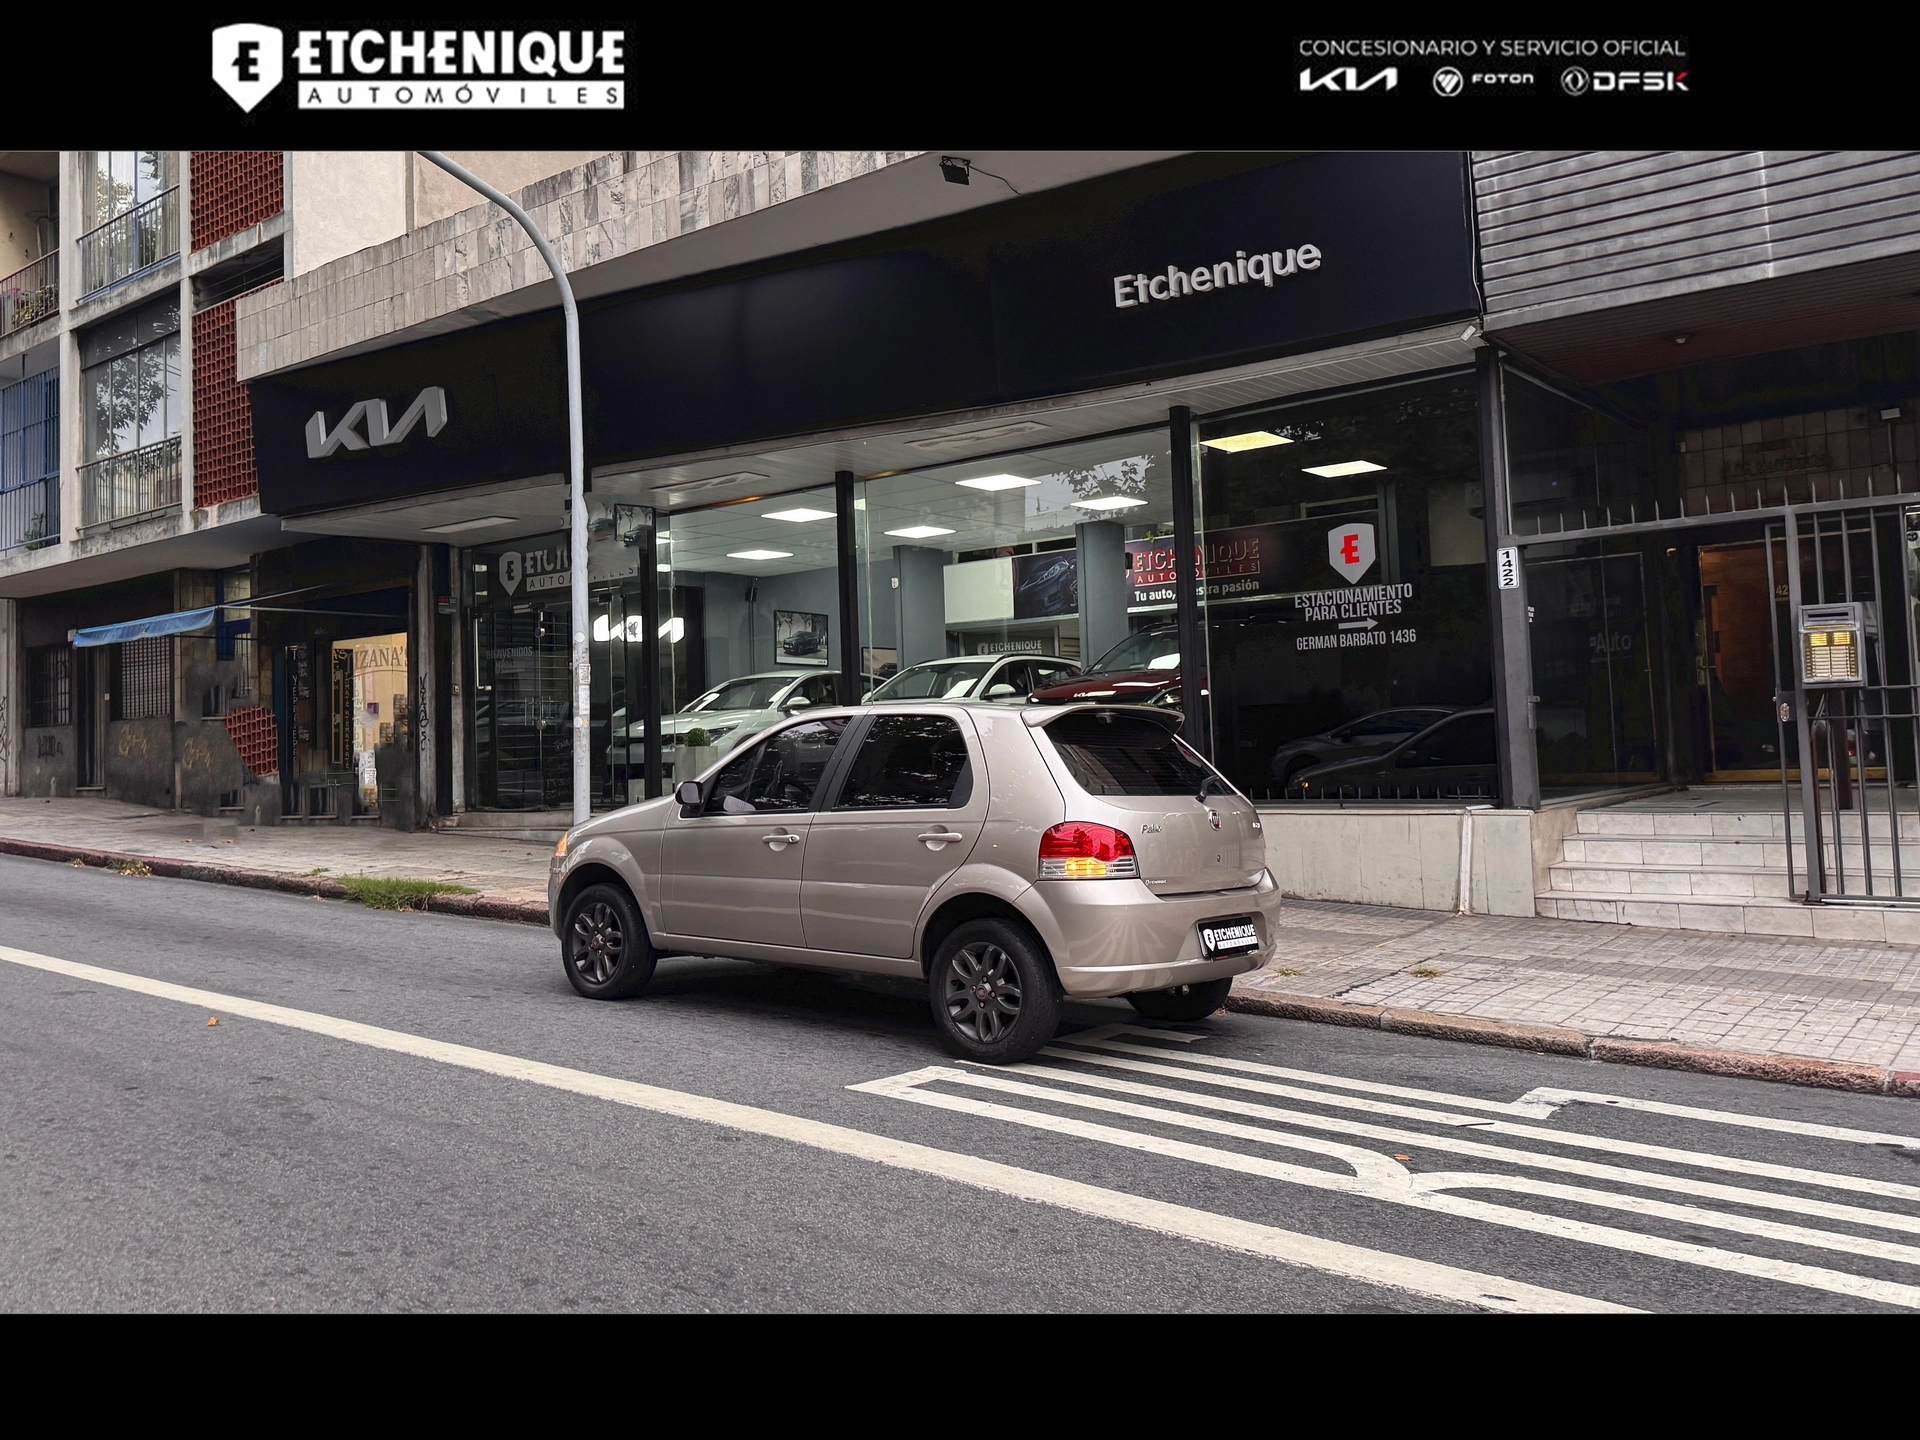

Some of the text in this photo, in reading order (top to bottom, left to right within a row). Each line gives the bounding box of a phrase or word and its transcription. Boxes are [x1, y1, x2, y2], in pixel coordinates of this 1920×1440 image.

[1113, 243, 1322, 308] Etchenique
[305, 386, 448, 458] KIA
[1133, 539, 1259, 573] ETCHNIQUE
[1502, 550, 1514, 586] 1422
[1134, 590, 1147, 601] Tu
[1149, 588, 1176, 601] auto,
[1222, 579, 1260, 595] pasión
[1294, 583, 1413, 608] ESTACIONAMIENTO
[1305, 599, 1402, 622] PARA CLIENTES
[990, 640, 1042, 652] ETCHENIQUE
[1296, 628, 1417, 650] GERMAN BARBATO 1436
[1213, 924, 1256, 941] ETCHENIQUE
